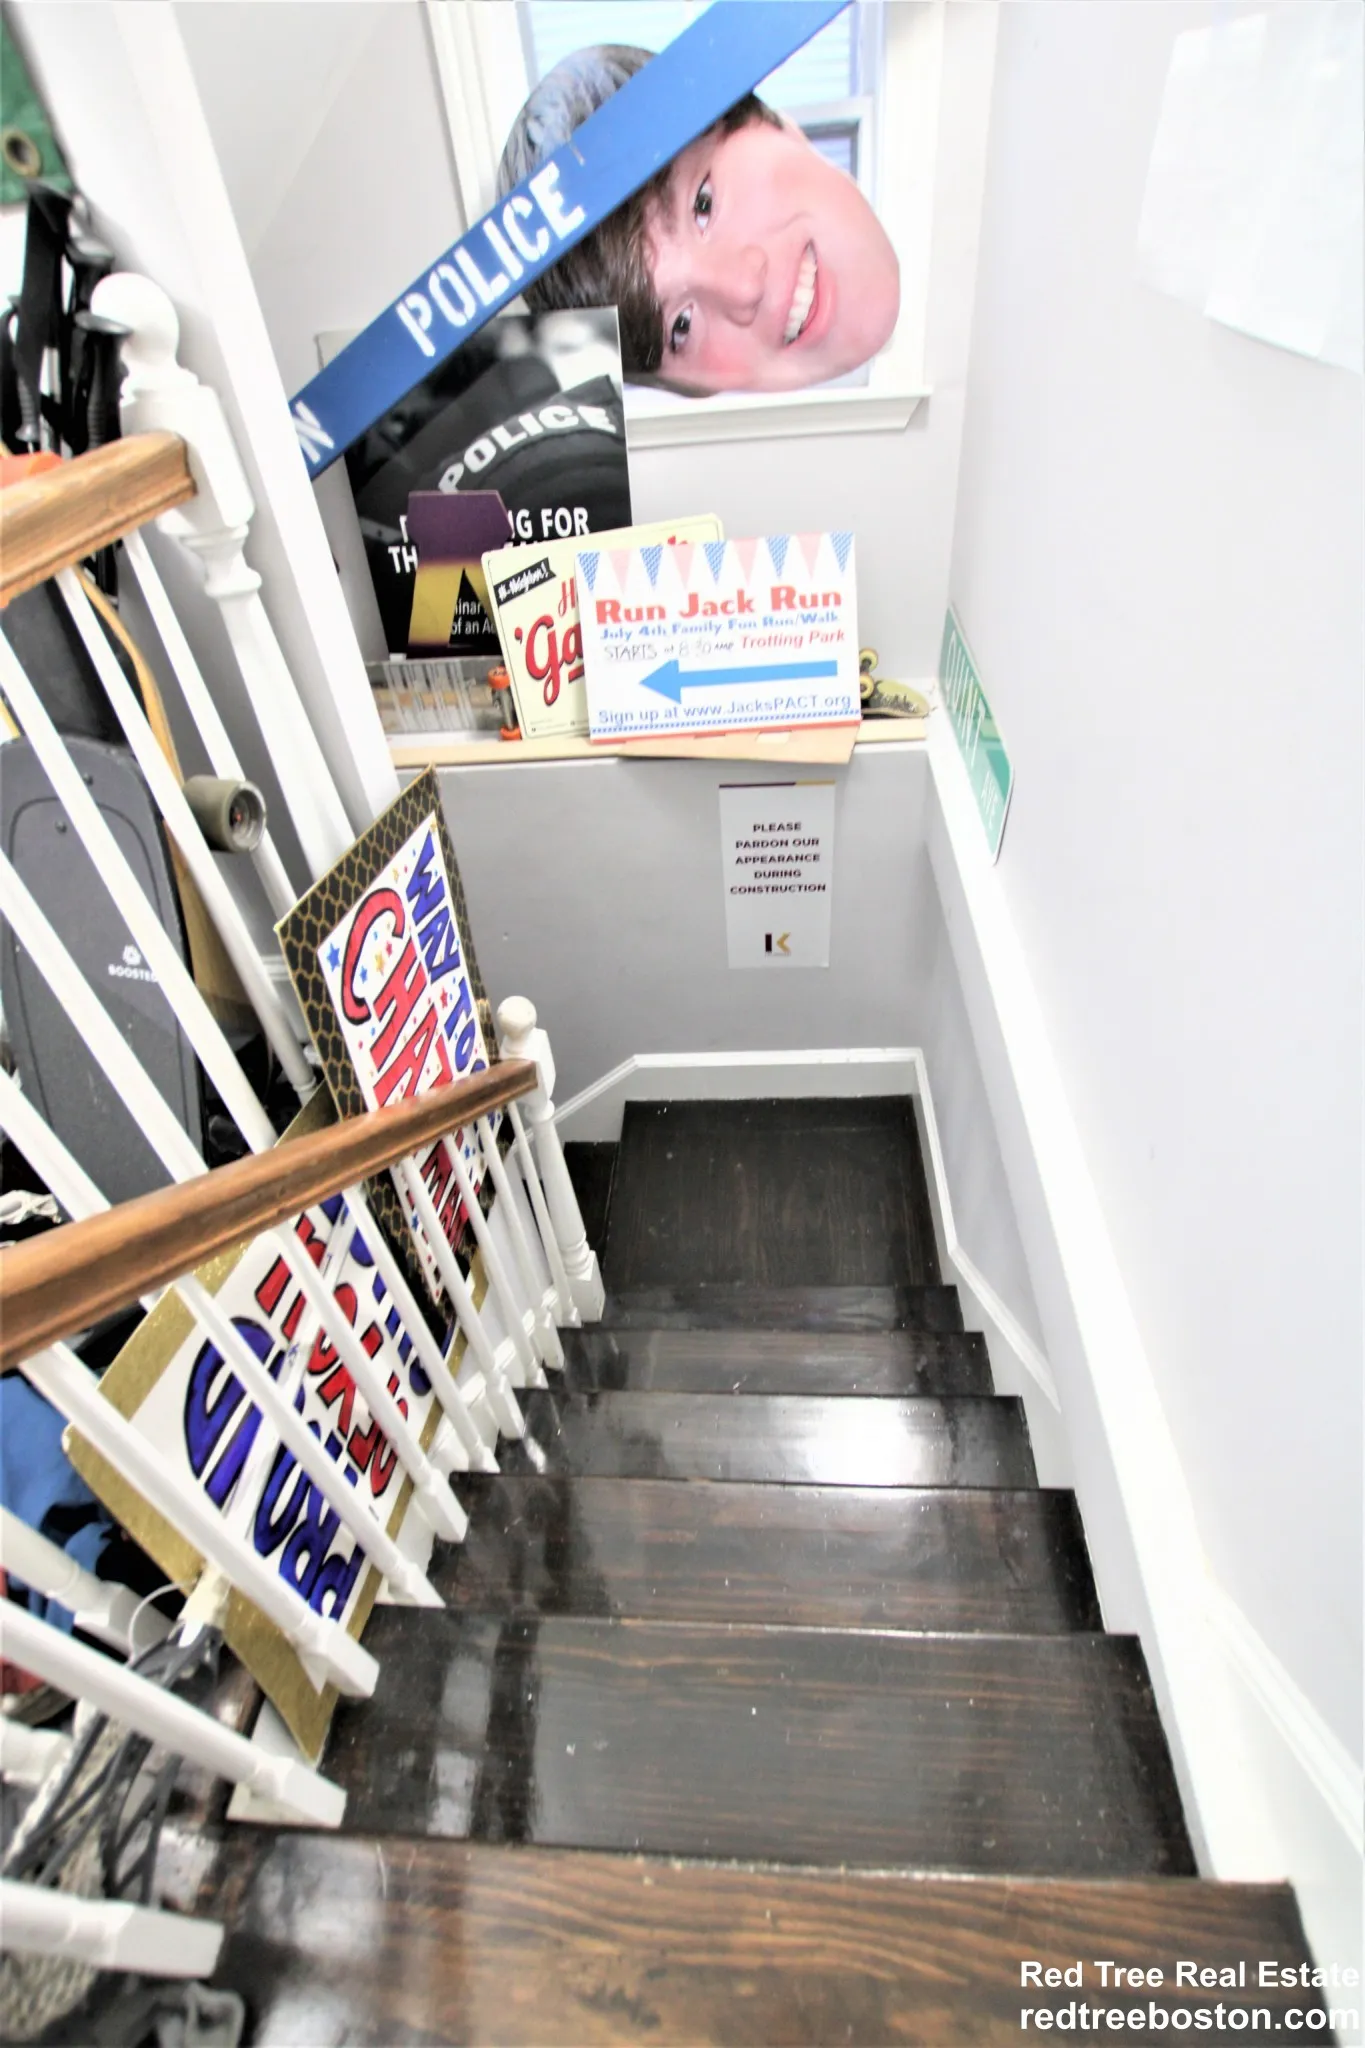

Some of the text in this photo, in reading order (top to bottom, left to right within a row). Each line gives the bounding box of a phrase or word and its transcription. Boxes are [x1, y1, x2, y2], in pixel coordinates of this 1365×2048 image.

[395, 160, 587, 358] POLICE
[437, 404, 618, 494] POLICE
[540, 506, 591, 539] FOR
[595, 585, 842, 625] Run Jack Run
[465, 620, 480, 635] an
[601, 610, 839, 642] July 4th Family Fun Run/Walk
[740, 627, 846, 650] Trotting Park
[603, 642, 658, 661] STARTS
[598, 708, 635, 727] Sign
[639, 709, 660, 725] up
[664, 705, 679, 720] at
[682, 694, 852, 720] www.JacksPACT.org
[752, 820, 802, 833] PLEASE
[734, 837, 820, 850] PARDON OUR
[734, 852, 821, 866] APPEARANCE
[753, 868, 802, 880] DURING
[729, 882, 827, 896] CONSTRUCTION
[405, 829, 477, 1073] WAY TO
